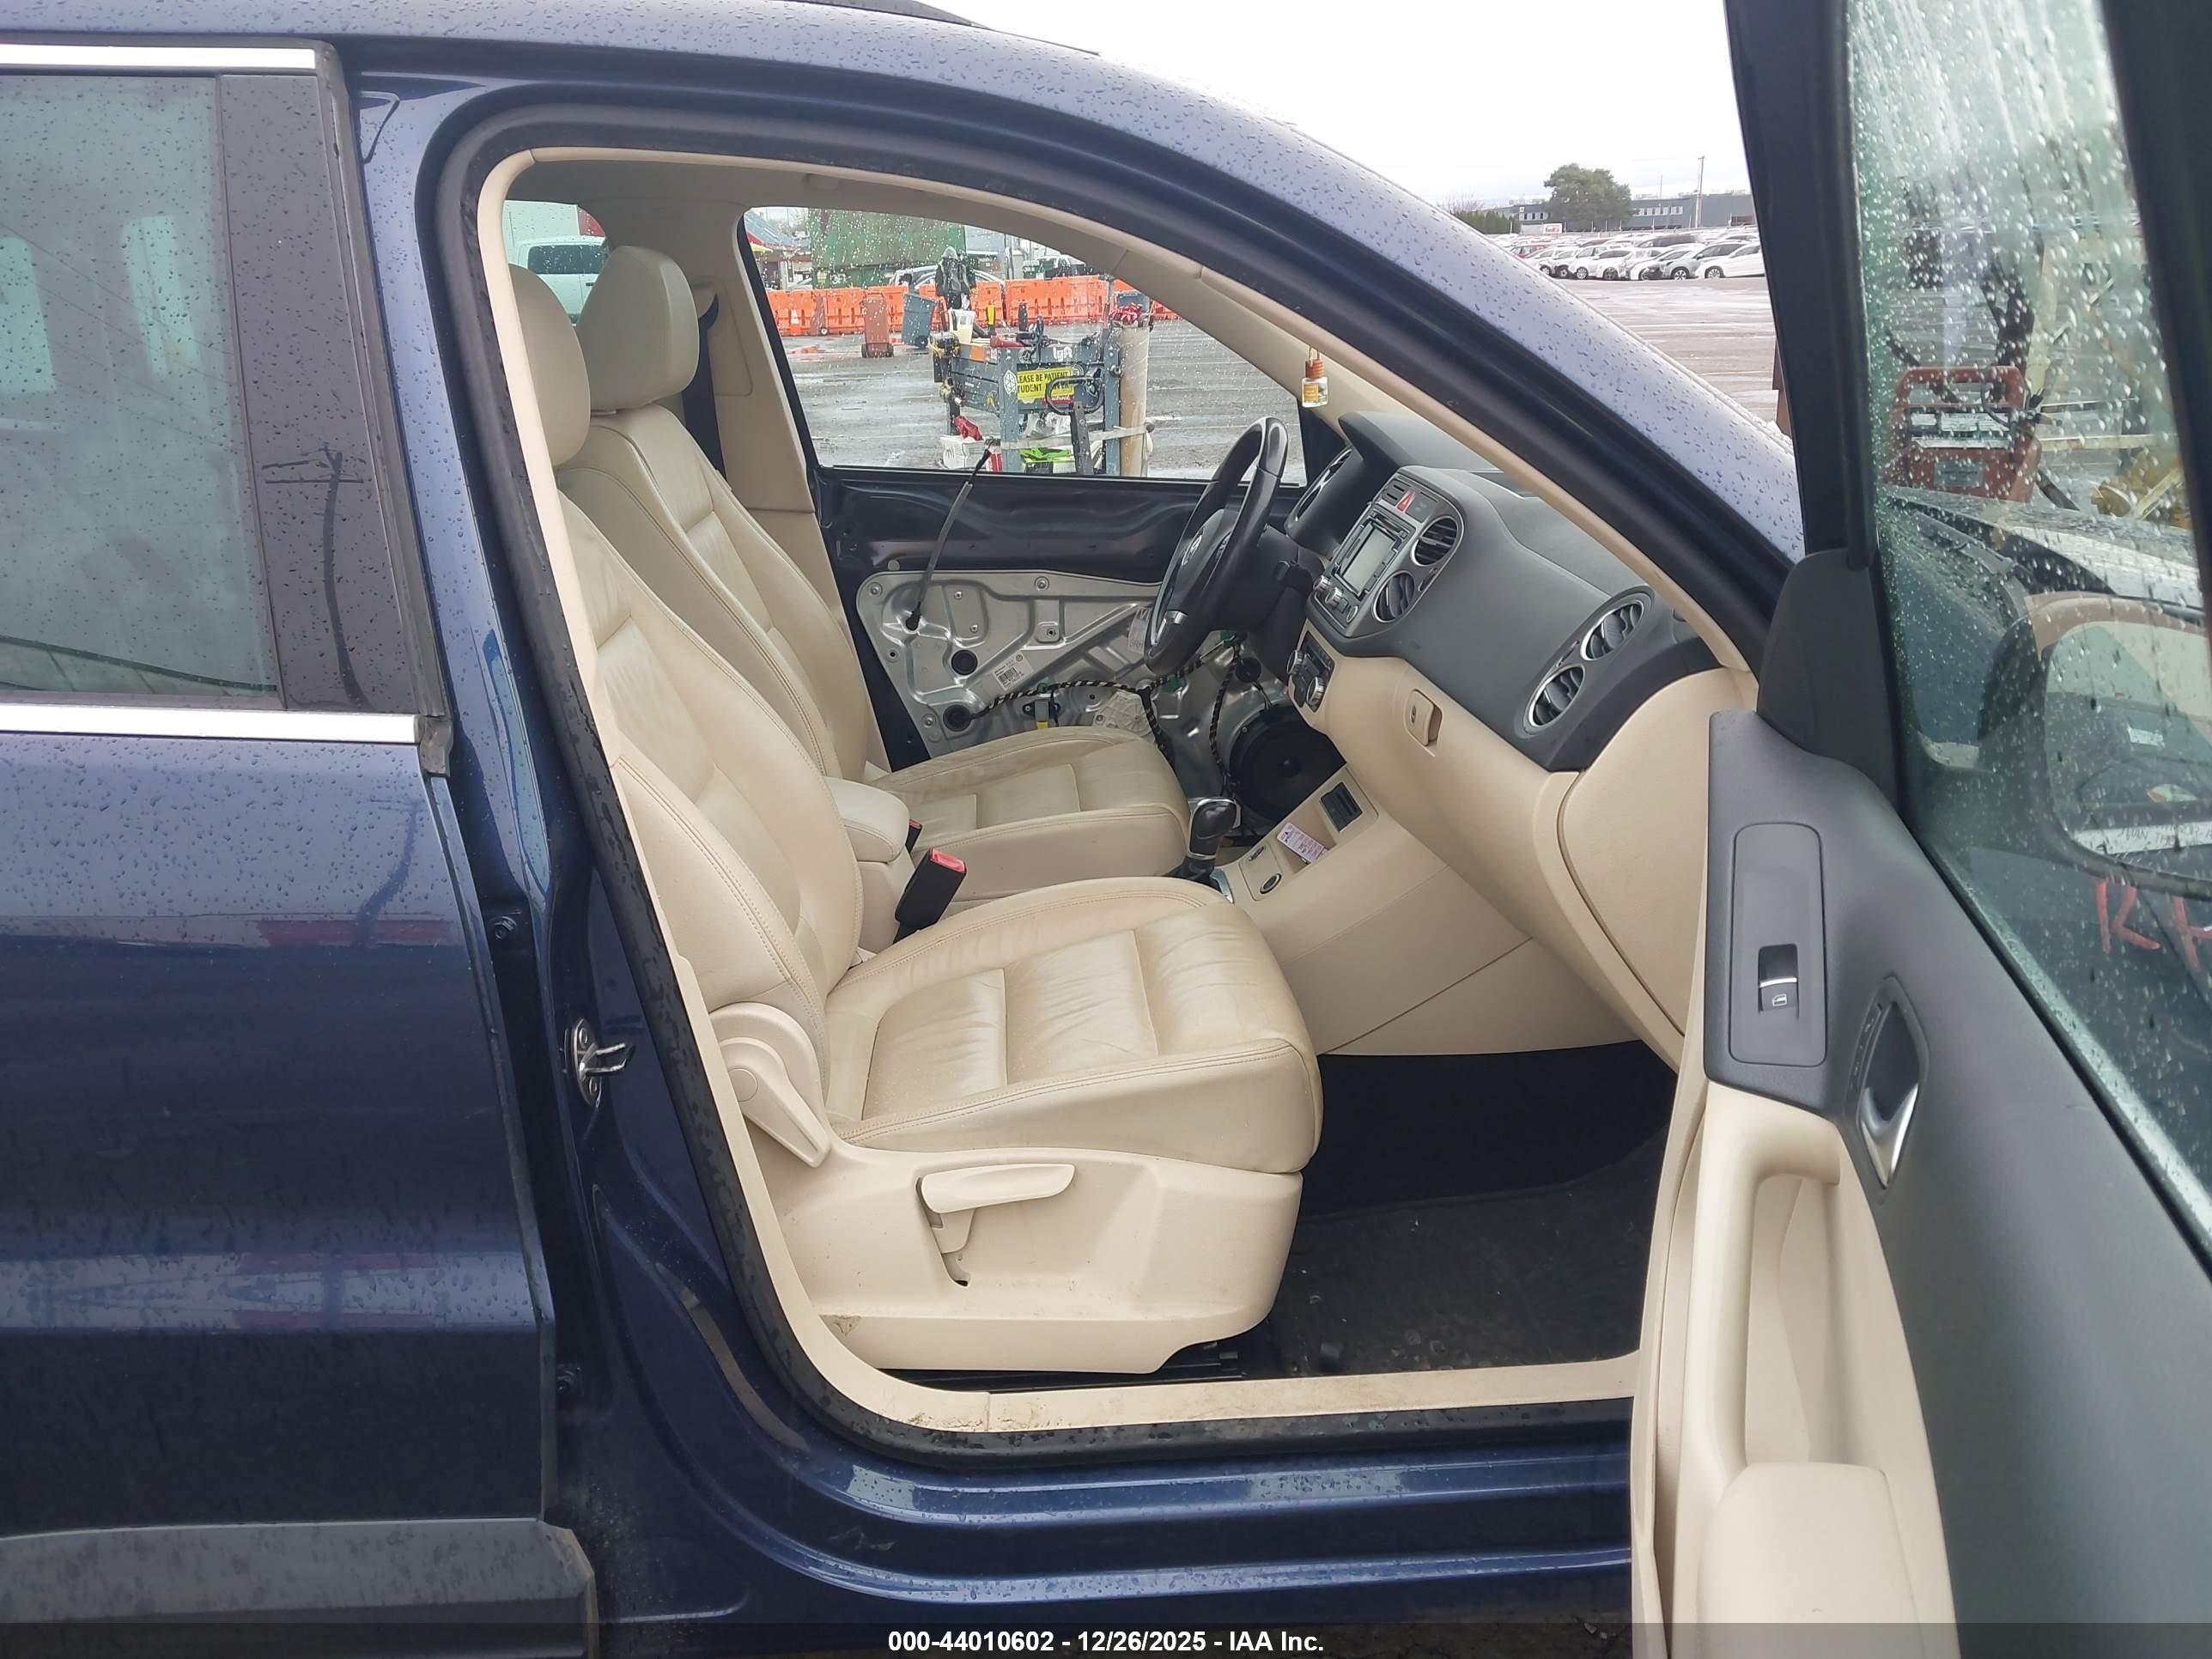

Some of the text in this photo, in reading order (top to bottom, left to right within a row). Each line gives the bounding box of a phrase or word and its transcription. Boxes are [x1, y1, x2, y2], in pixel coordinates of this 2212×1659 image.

[1017, 374, 1035, 384] LEASE
[1036, 373, 1043, 382] BE
[1017, 383, 1042, 393] TUDENT
